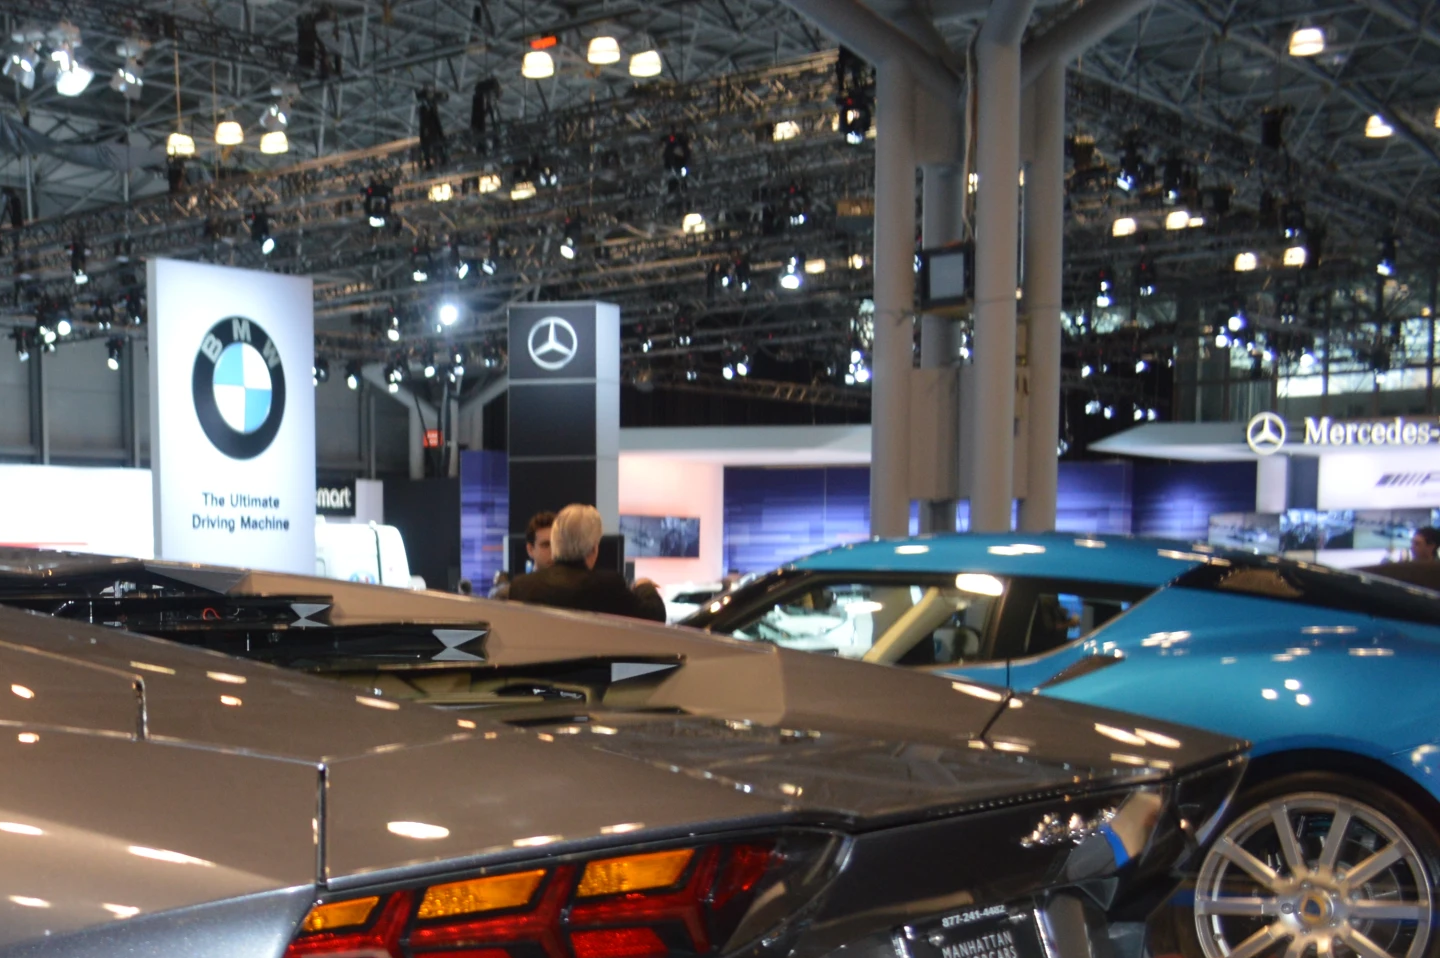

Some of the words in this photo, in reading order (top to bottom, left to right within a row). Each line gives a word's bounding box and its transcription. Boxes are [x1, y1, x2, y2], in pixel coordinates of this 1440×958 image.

[200, 318, 280, 369] BMW
[1303, 415, 1440, 446] Mercedes-
[202, 492, 225, 507] The
[230, 492, 280, 509] Ultimate
[316, 486, 351, 509] mart
[192, 513, 235, 534] Driving
[240, 515, 290, 531] Machine
